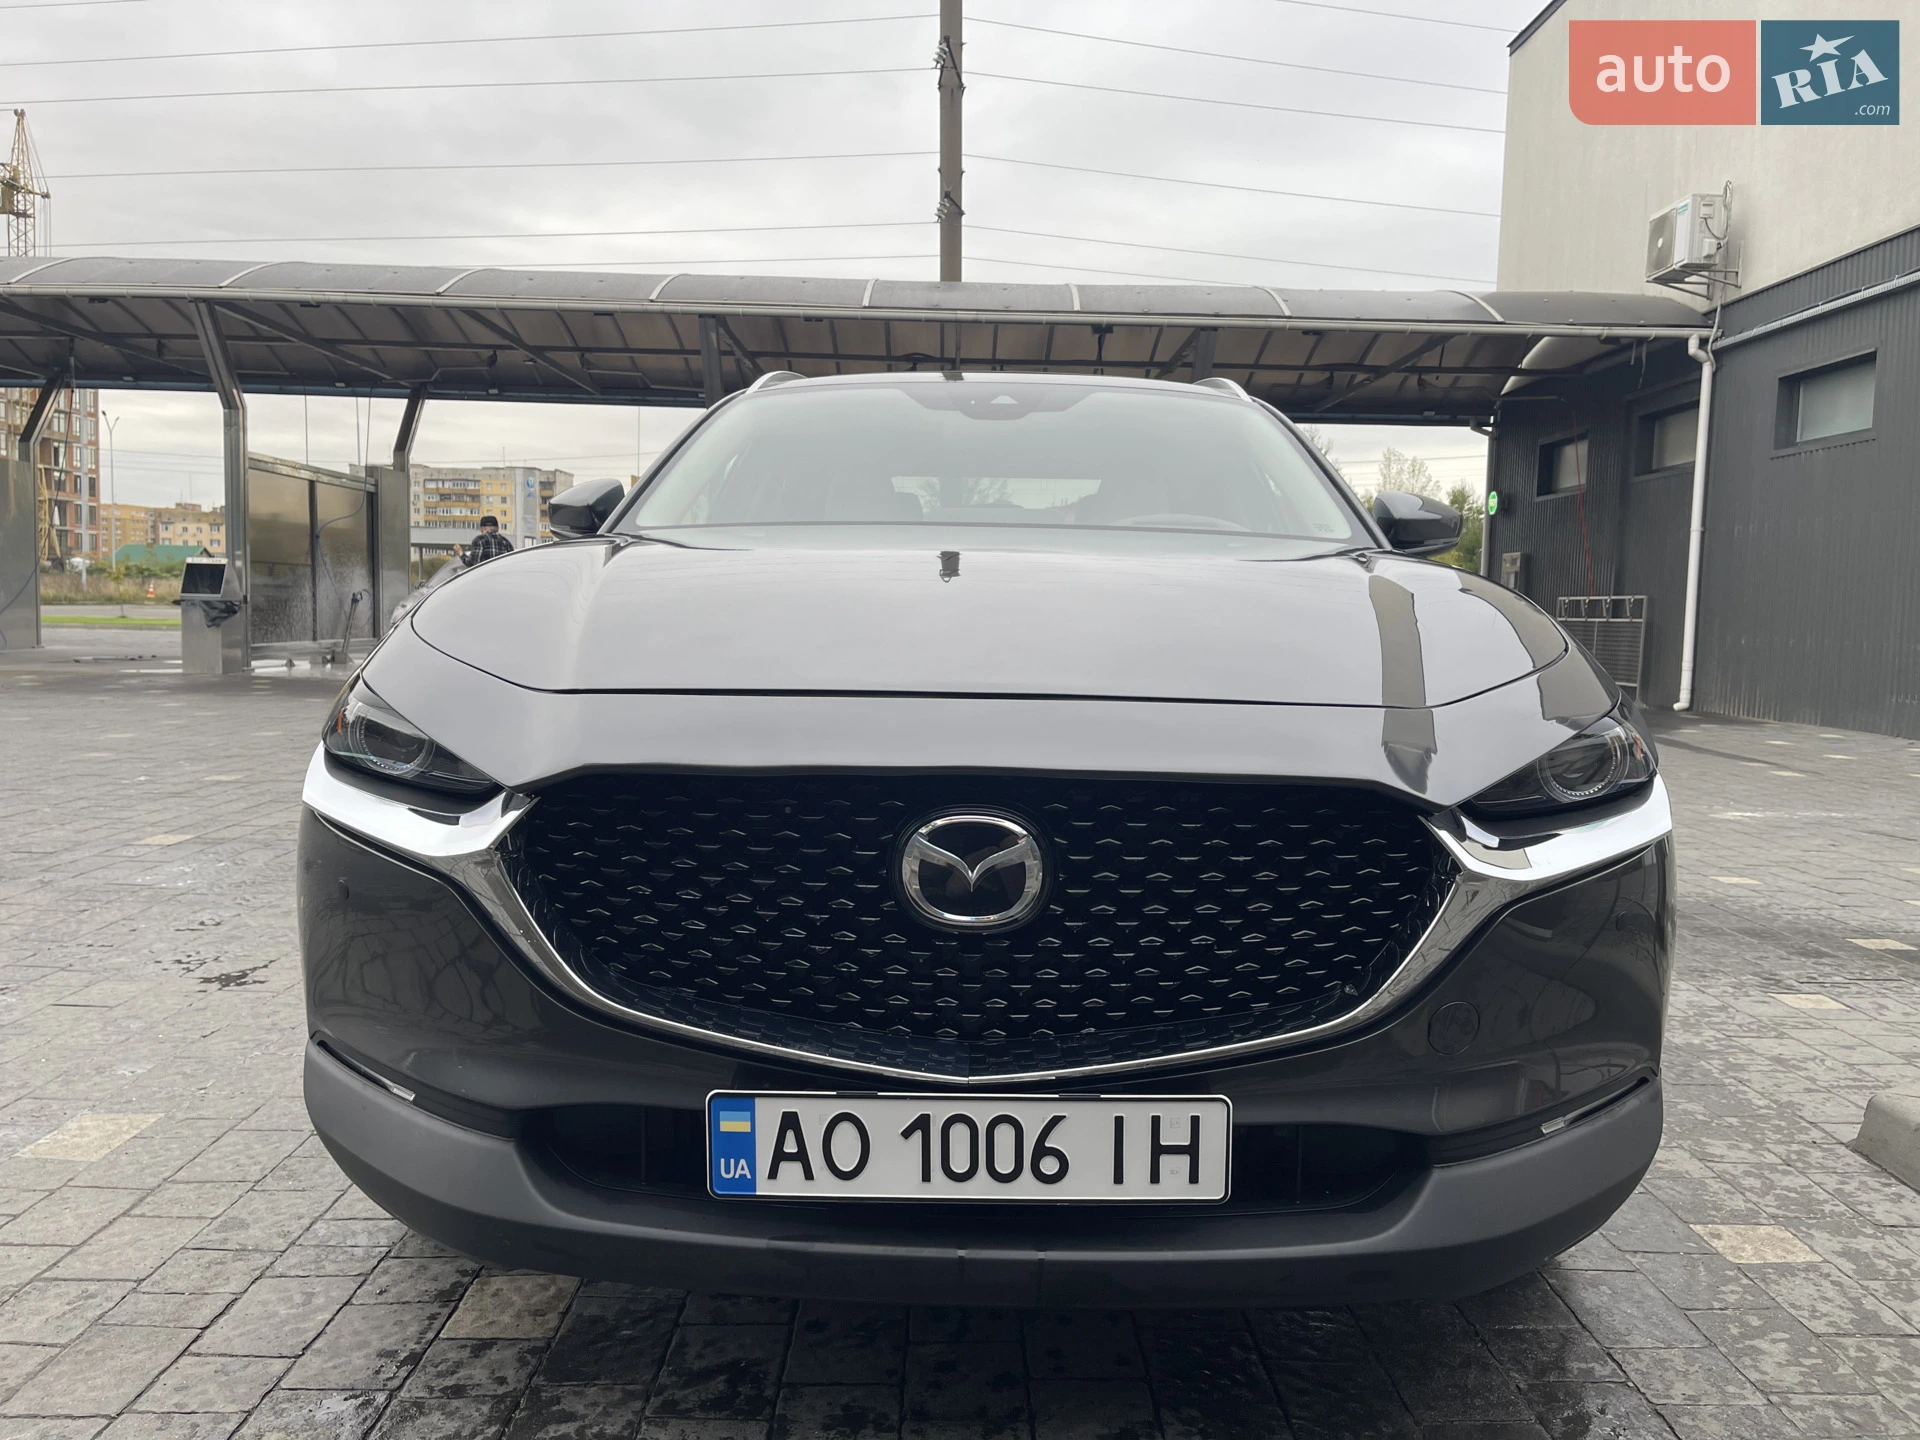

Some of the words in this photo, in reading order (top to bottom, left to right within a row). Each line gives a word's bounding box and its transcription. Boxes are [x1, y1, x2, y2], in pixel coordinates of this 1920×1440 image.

[720, 1158, 752, 1179] UA
[767, 1110, 871, 1182] AO
[900, 1113, 1070, 1185] 1006
[1113, 1114, 1201, 1185] IH
